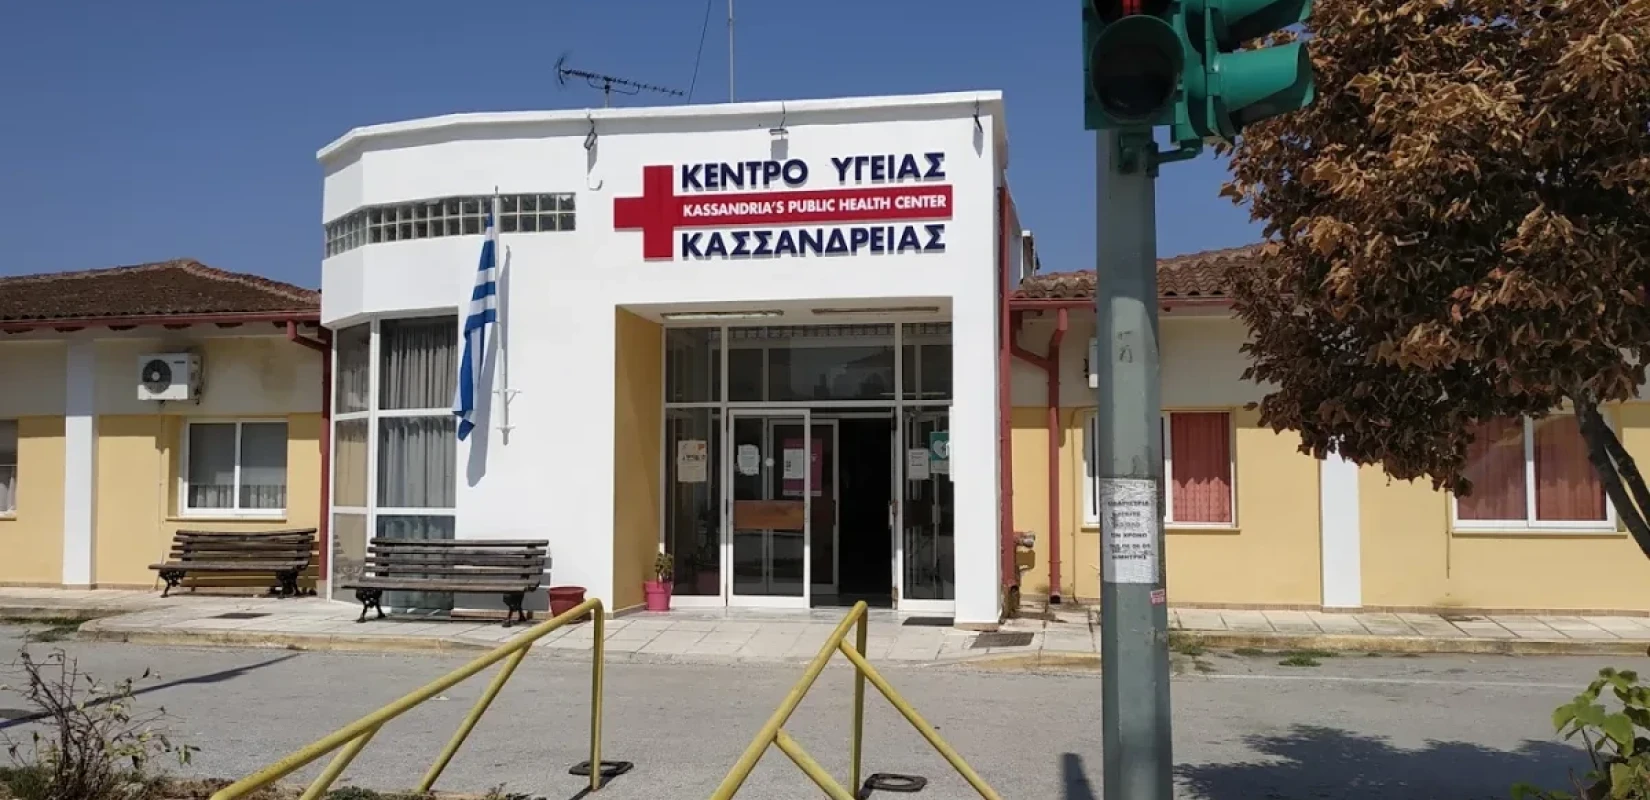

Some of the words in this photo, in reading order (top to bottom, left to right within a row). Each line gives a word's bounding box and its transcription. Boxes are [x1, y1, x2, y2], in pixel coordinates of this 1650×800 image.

[682, 158, 808, 190] ΚΕΝΤΡΟ
[831, 152, 946, 183] ΥΓΕΙΑΣ
[682, 201, 785, 217] KASSANDRIA'S
[787, 199, 836, 214] PUBLIC
[839, 196, 891, 211] HEALTH
[894, 194, 947, 209] CENTER
[682, 224, 946, 260] ΚΑΣΣΑΝΔΡΕΙΑΣ
